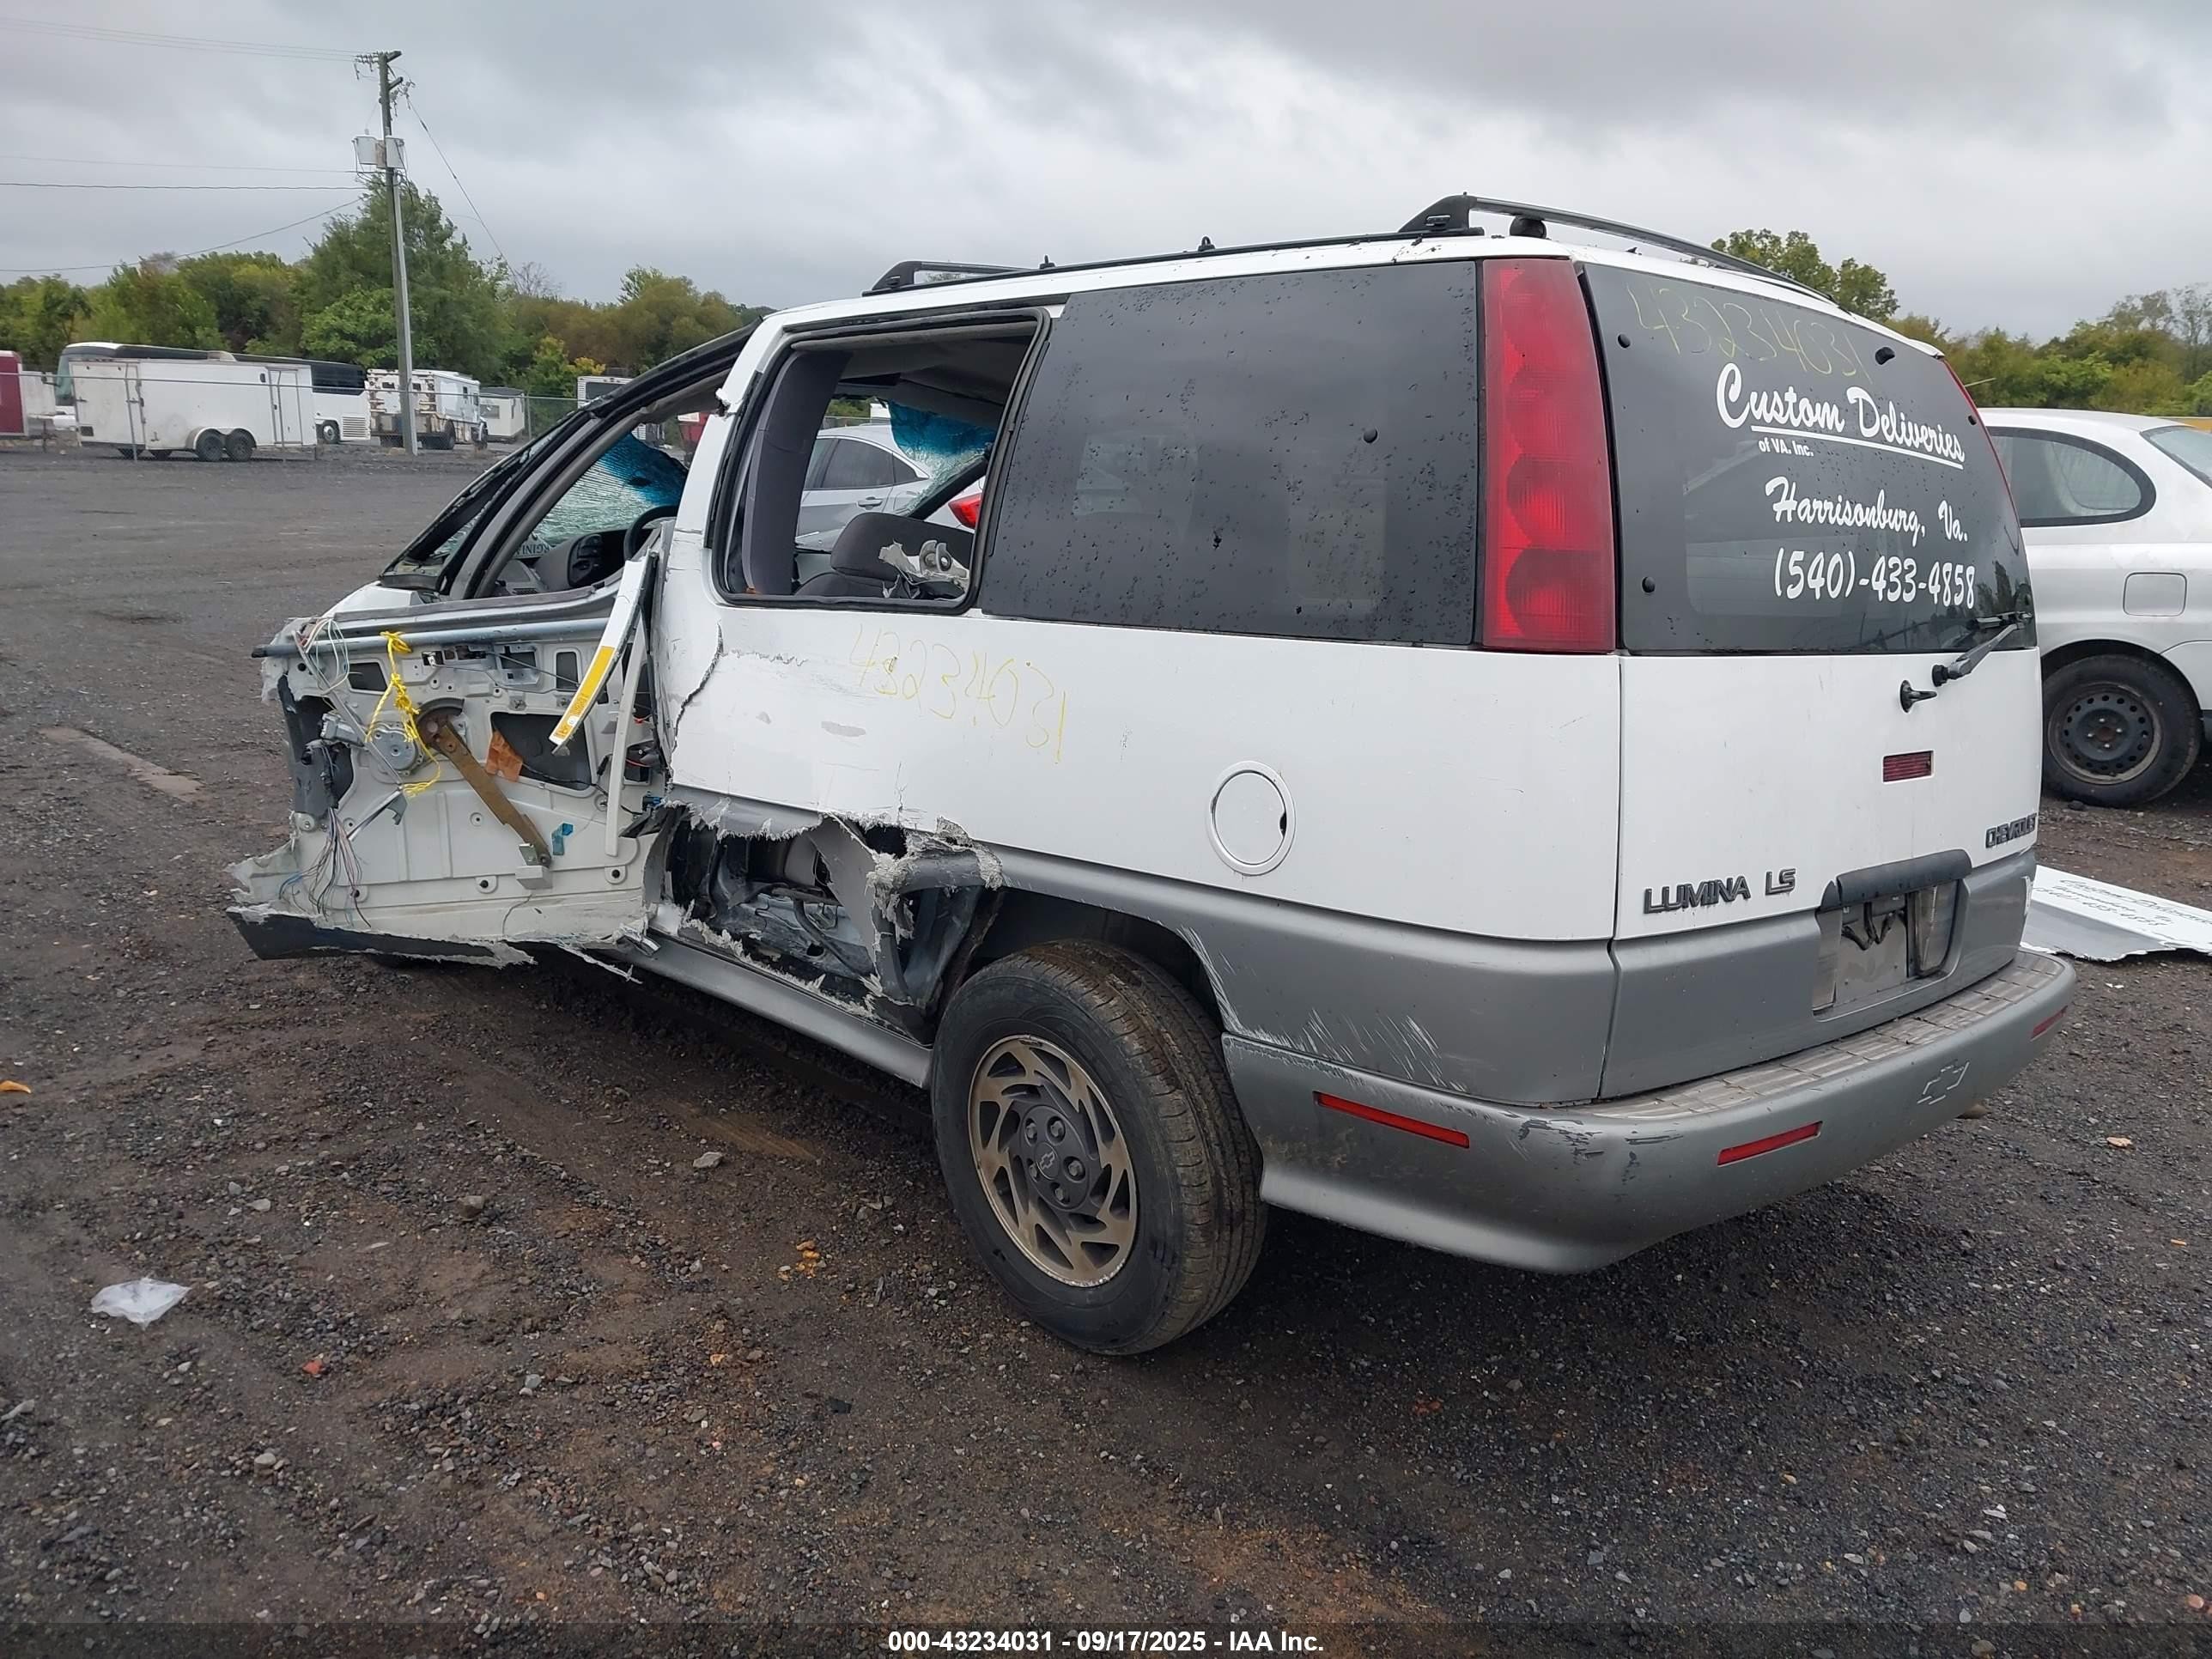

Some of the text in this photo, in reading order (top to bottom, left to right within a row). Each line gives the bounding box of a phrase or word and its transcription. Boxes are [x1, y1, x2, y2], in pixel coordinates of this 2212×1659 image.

[1627, 282, 1873, 384] 43234031
[1717, 362, 1965, 463] Custom Deliveries
[1758, 437, 1814, 457] of VA. Inc.
[1765, 476, 1969, 547] Harrisonburg, Va.
[1773, 548, 1976, 609] (540)-433-4858
[1985, 812, 2037, 848] CHEVROLET
[1644, 868, 1796, 915] LUMINA LS
